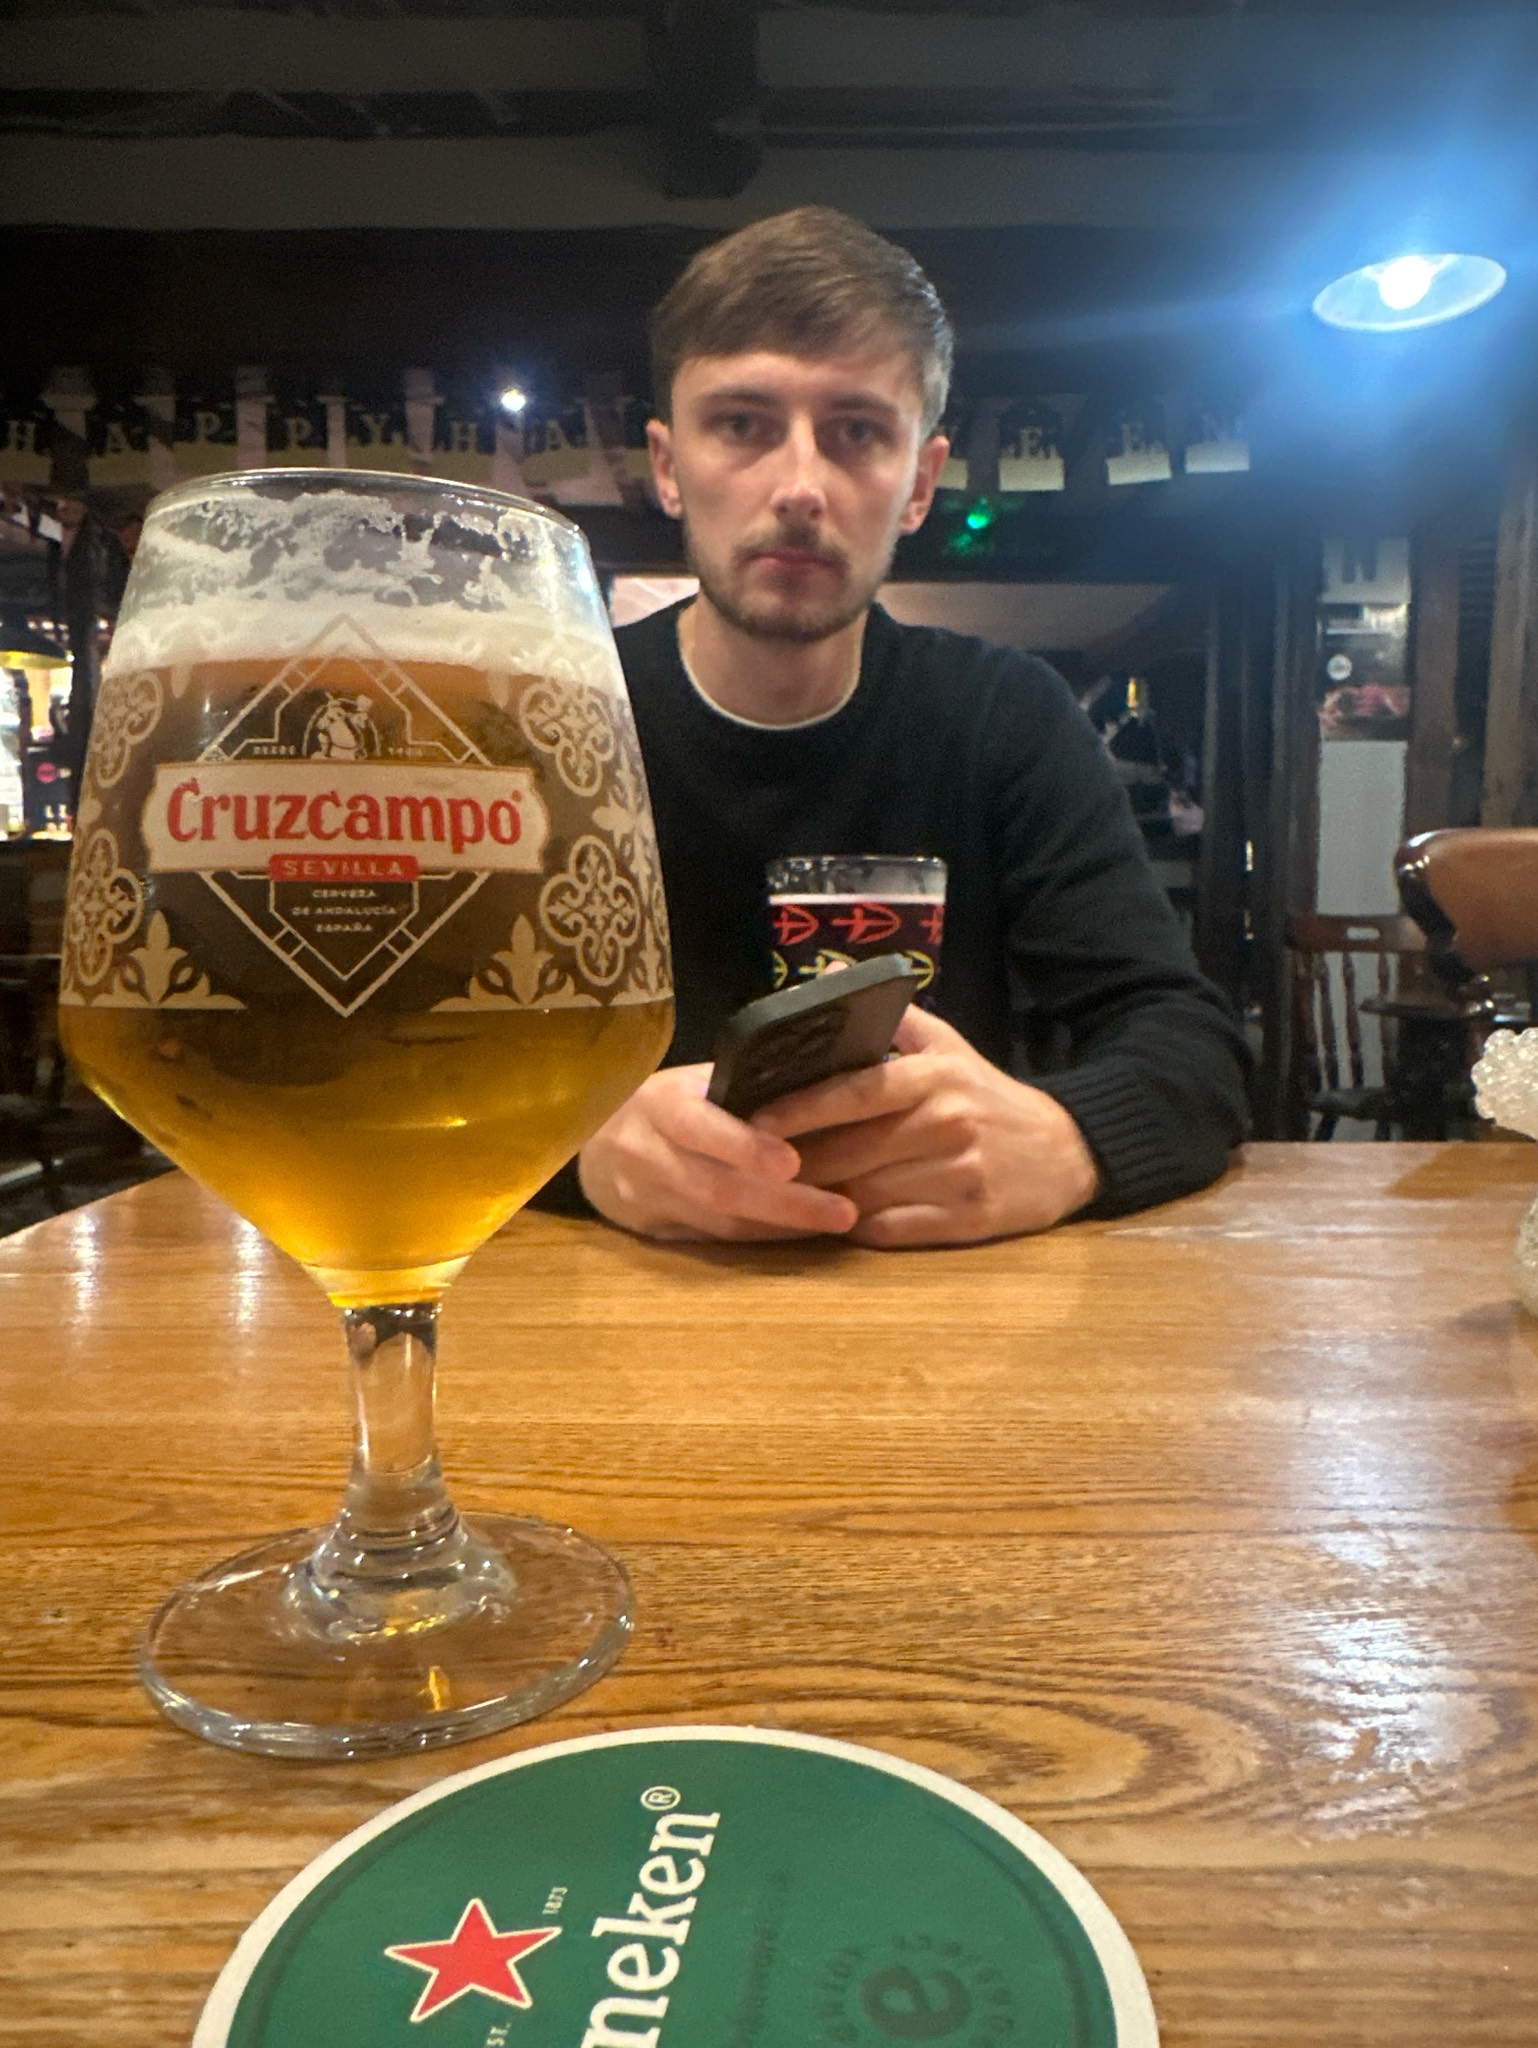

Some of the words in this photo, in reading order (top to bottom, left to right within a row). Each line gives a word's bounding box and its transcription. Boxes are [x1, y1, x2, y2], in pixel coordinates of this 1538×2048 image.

[166, 777, 523, 854] Cruzcampo
[282, 860, 404, 877] SEVILLA
[312, 888, 377, 899] CERVEZA
